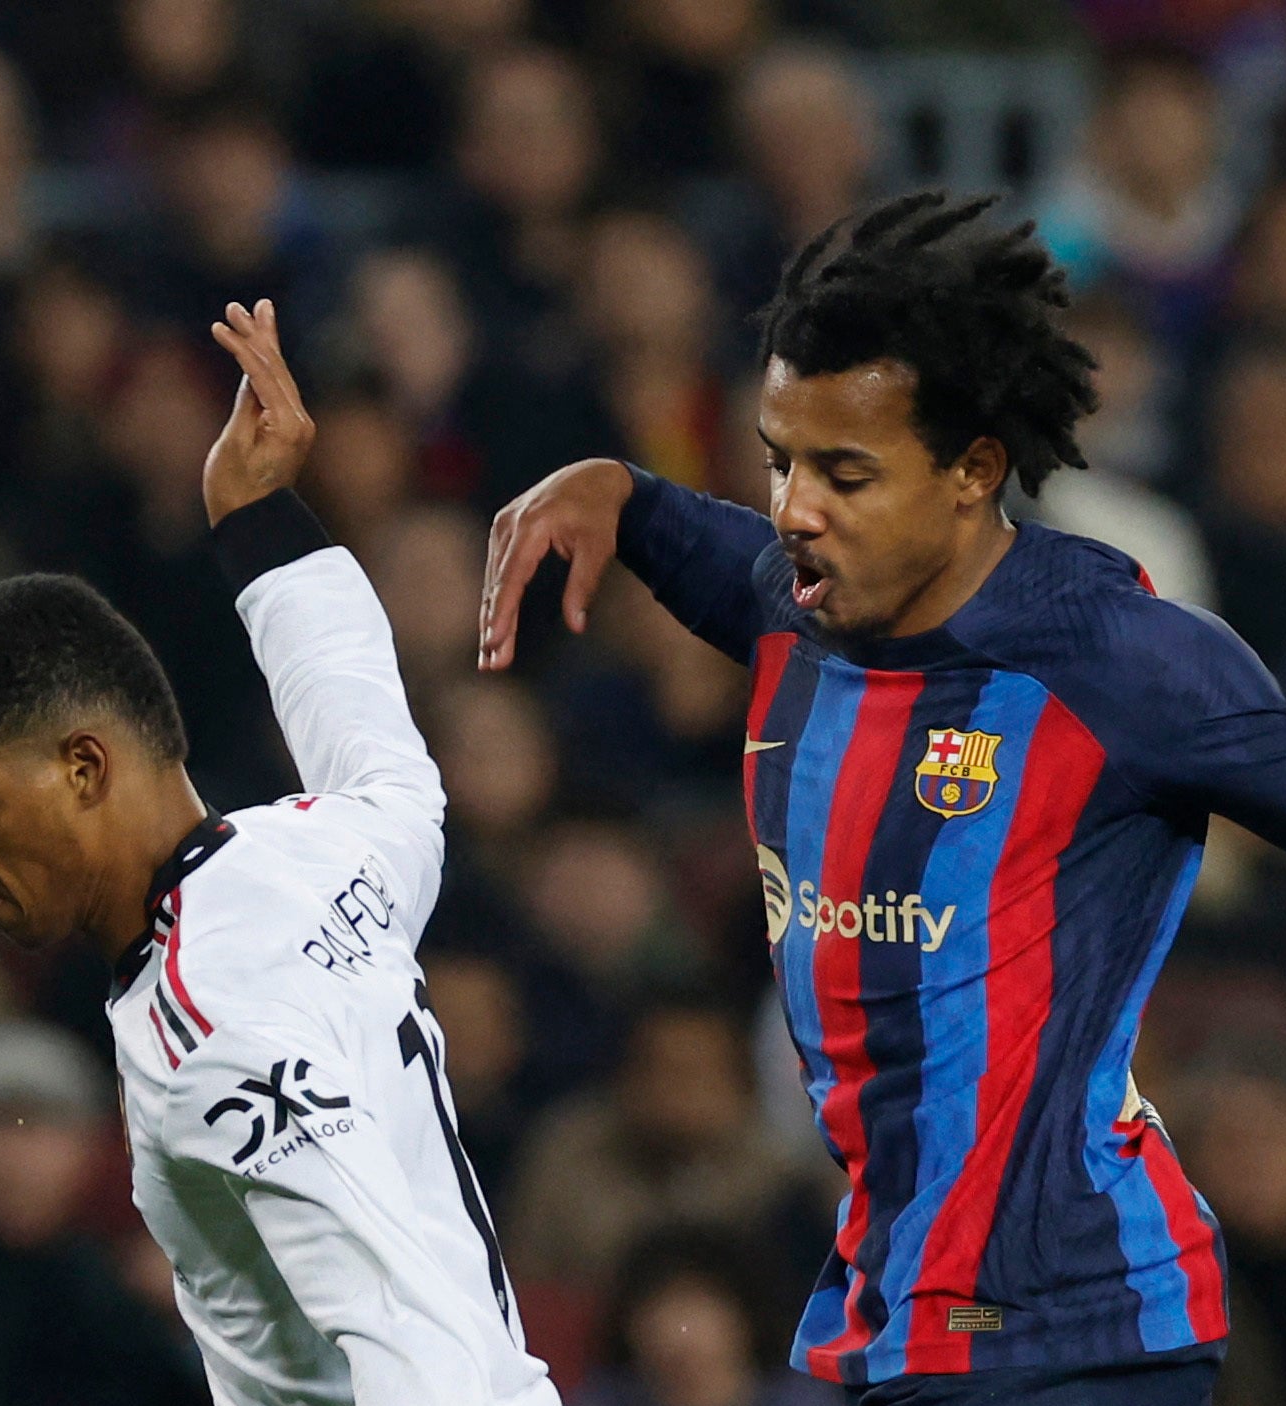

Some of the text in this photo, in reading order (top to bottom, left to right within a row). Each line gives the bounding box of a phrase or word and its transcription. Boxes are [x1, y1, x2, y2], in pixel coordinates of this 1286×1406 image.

[939, 765, 971, 777] FCB
[798, 880, 957, 952] Spotify
[243, 1118, 357, 1182] TECHNLOG
